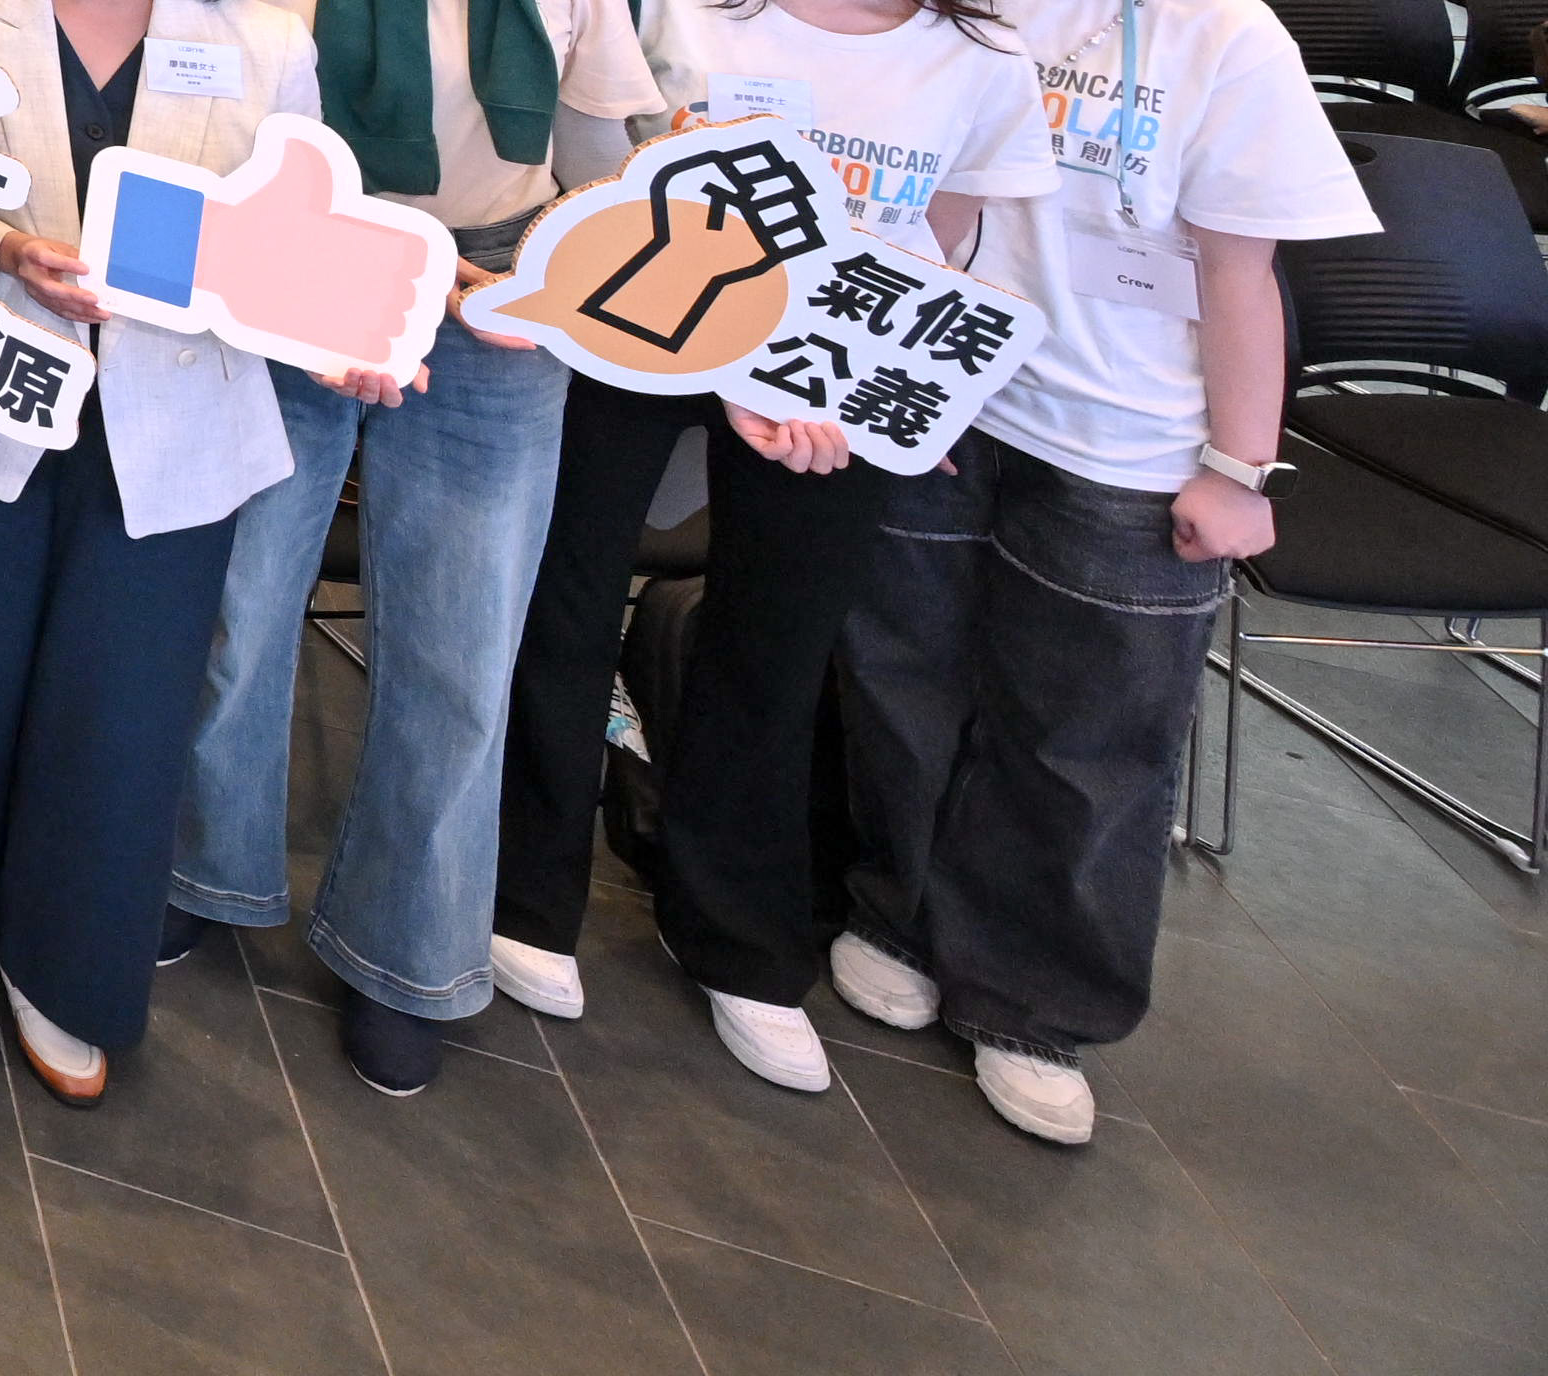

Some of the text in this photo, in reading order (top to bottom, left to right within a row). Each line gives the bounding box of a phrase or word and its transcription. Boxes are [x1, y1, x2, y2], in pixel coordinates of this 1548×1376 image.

[807, 252, 1016, 377] 氣候
[1116, 274, 1155, 291] Crew
[749, 332, 952, 450] 公義
